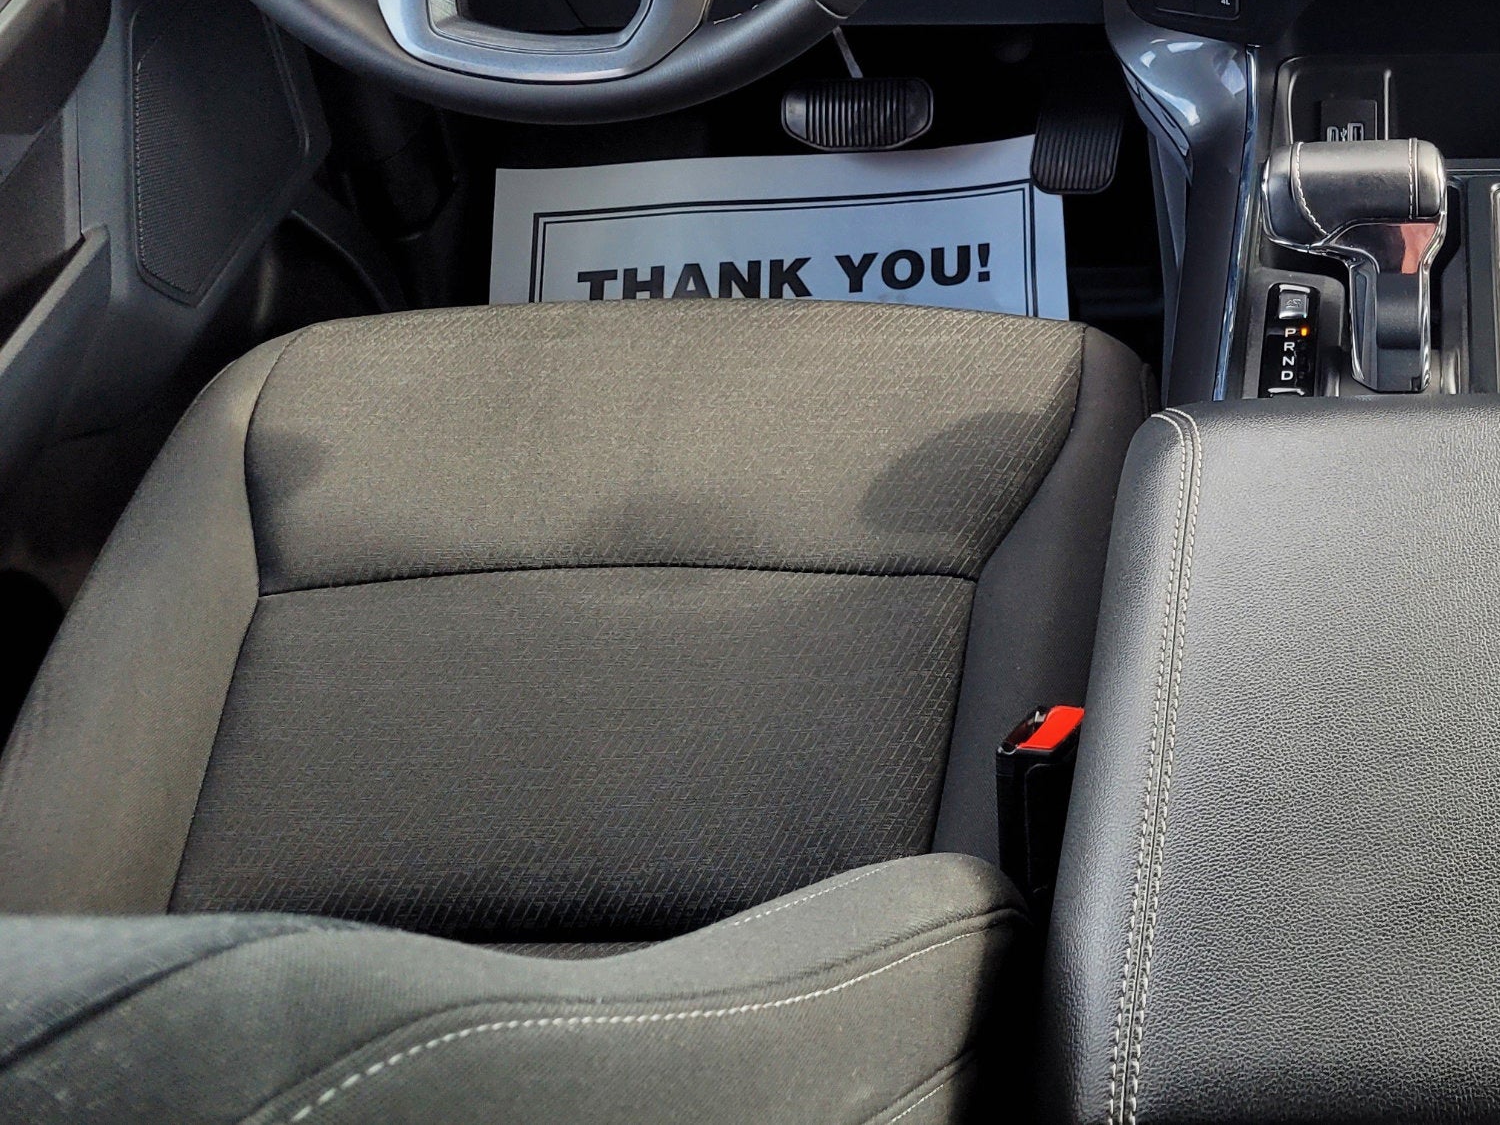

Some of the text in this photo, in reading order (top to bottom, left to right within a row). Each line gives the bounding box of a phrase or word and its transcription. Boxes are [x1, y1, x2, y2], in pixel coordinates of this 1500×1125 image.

[577, 242, 992, 301] THANK YOU!
[1284, 328, 1297, 338] P
[1283, 342, 1296, 352] R
[1282, 356, 1295, 366] N
[1281, 370, 1294, 381] D
